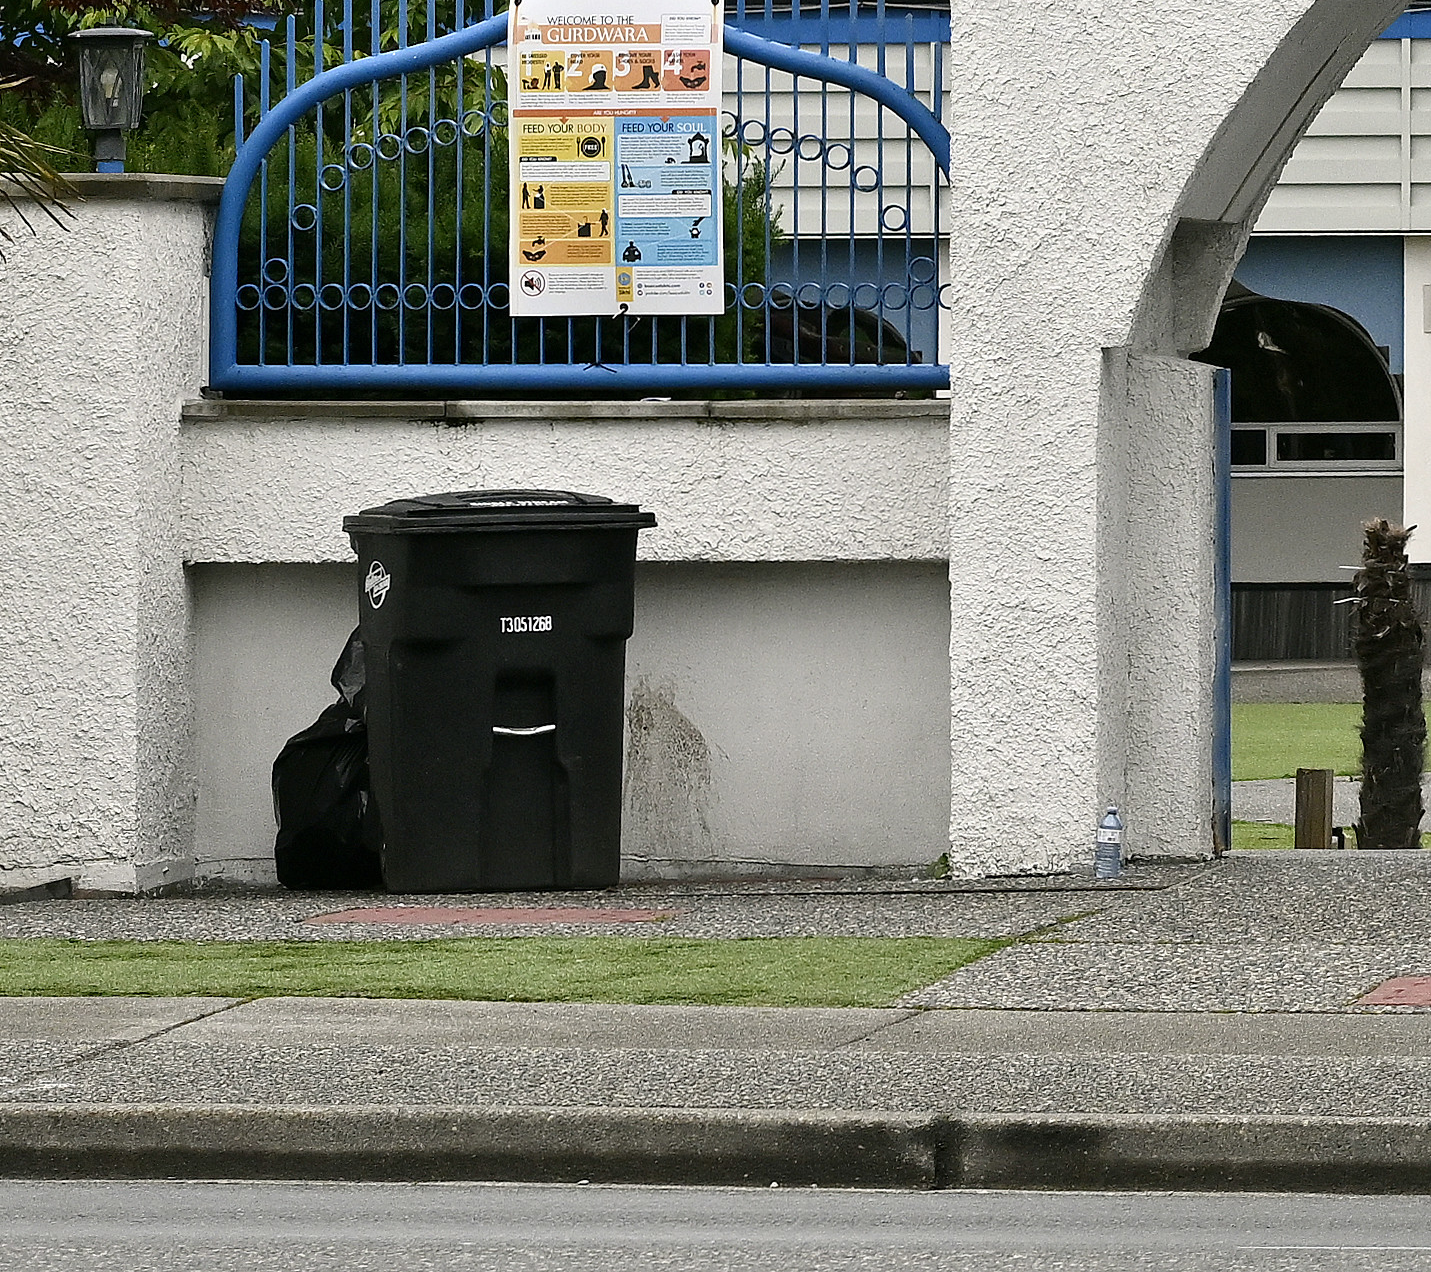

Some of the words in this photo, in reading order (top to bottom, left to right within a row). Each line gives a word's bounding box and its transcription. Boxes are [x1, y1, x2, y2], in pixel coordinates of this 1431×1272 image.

[547, 15, 597, 25] WELCOME
[600, 15, 613, 25] TO
[616, 15, 634, 25] THE
[546, 26, 649, 43] GURDWARA
[522, 123, 545, 134] FEED
[547, 123, 574, 134] YOUR
[577, 123, 607, 134] BODY
[622, 122, 645, 133] FEED
[647, 122, 674, 133] YOUR
[677, 122, 707, 133] SOUL
